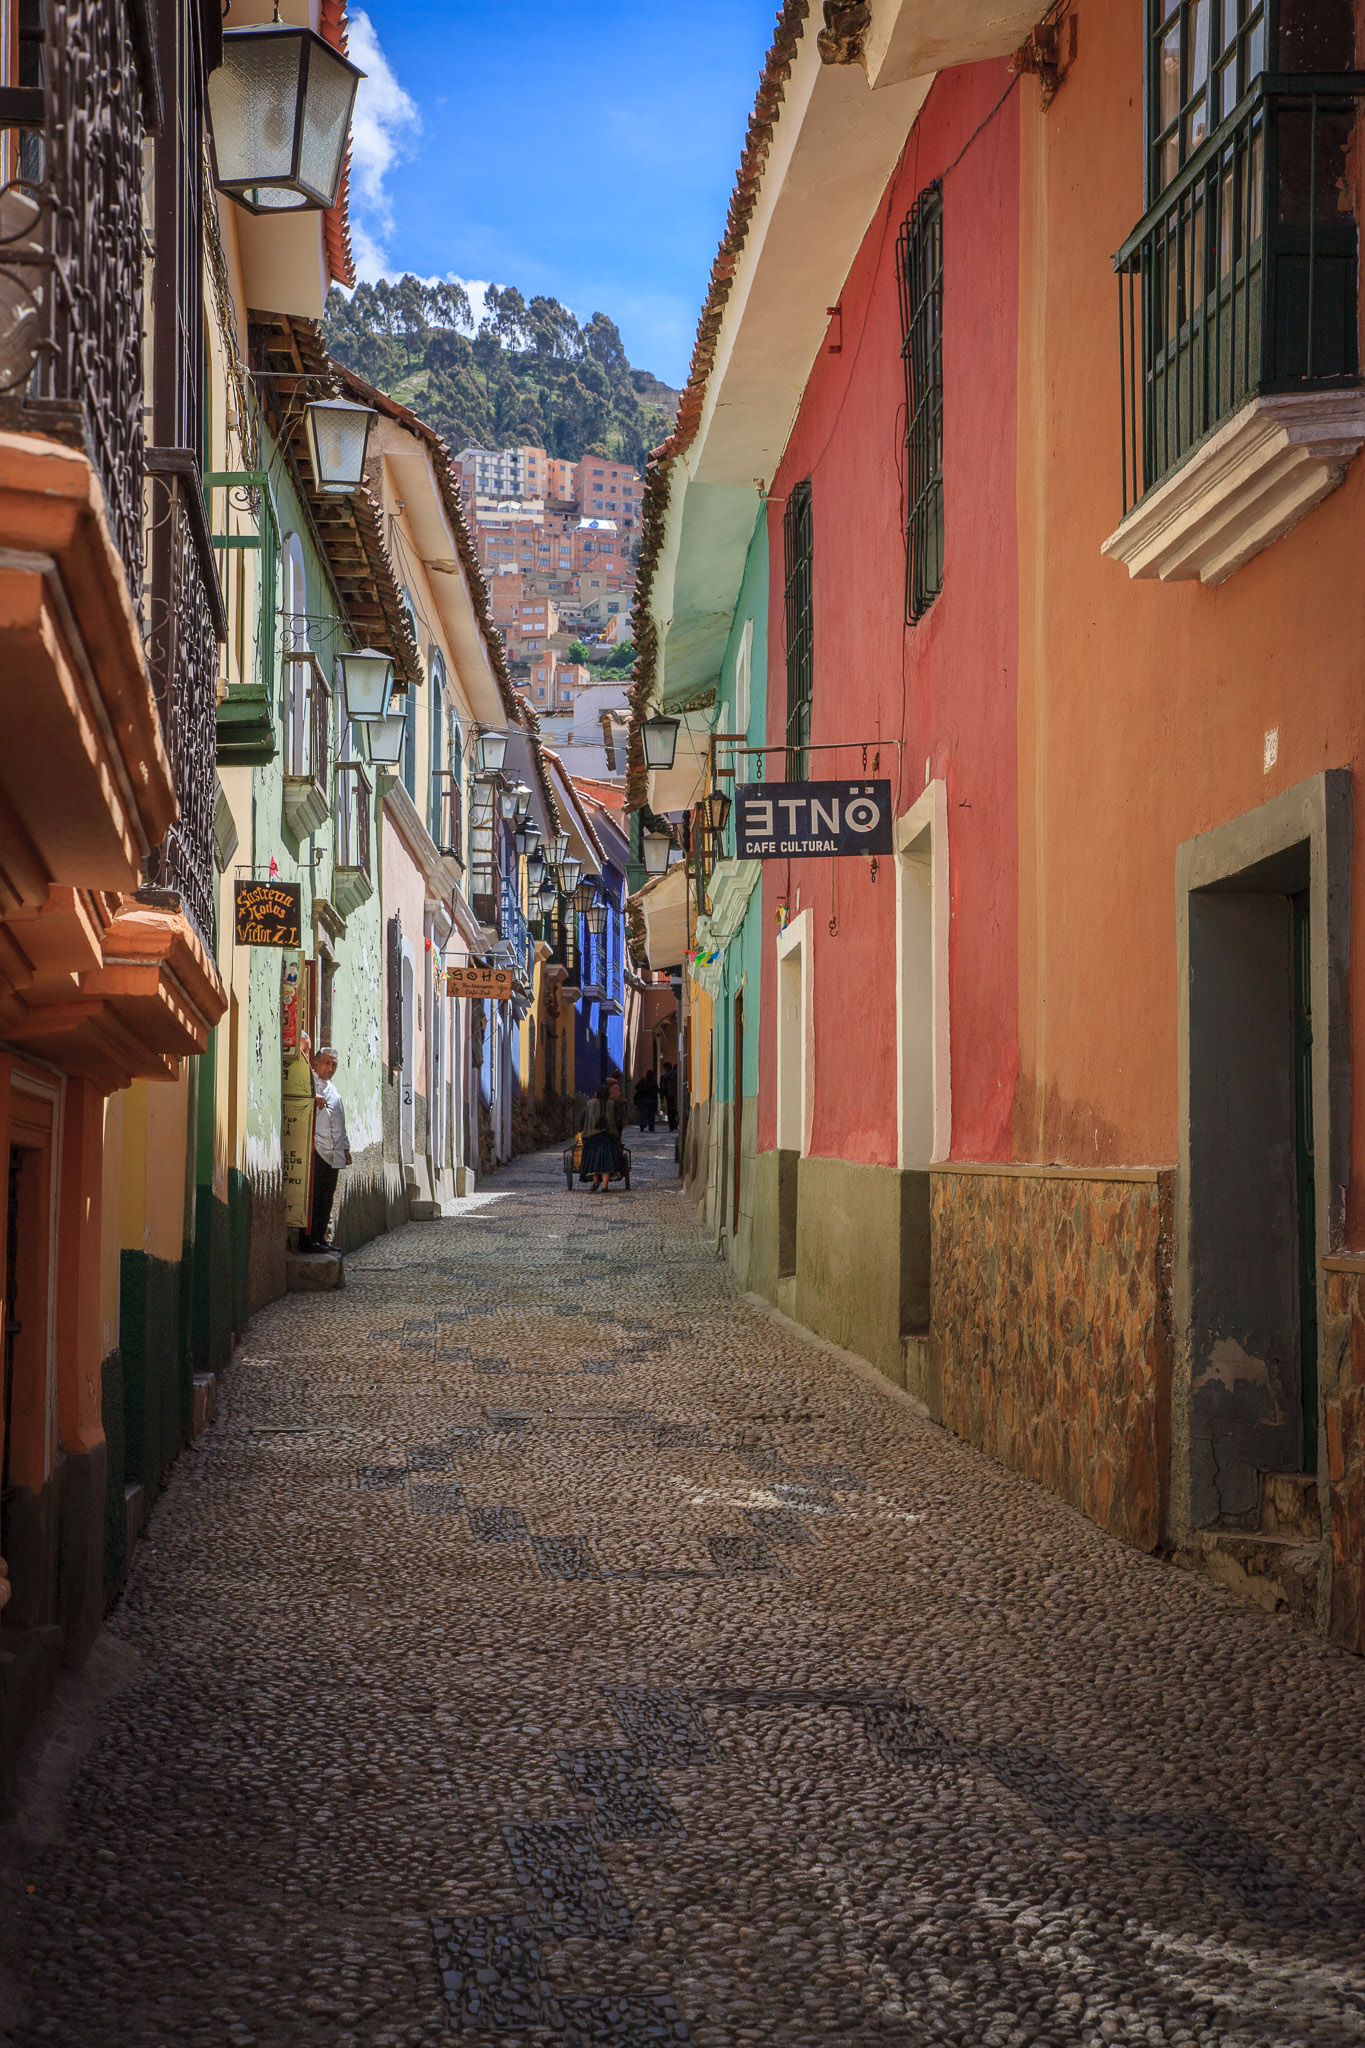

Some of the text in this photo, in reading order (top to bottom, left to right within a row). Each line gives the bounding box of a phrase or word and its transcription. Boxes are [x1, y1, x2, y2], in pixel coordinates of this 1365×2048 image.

[746, 840, 838, 853] CAFE CULTURAL
[237, 921, 272, 942] Victor
[453, 970, 506, 982] SOHO
